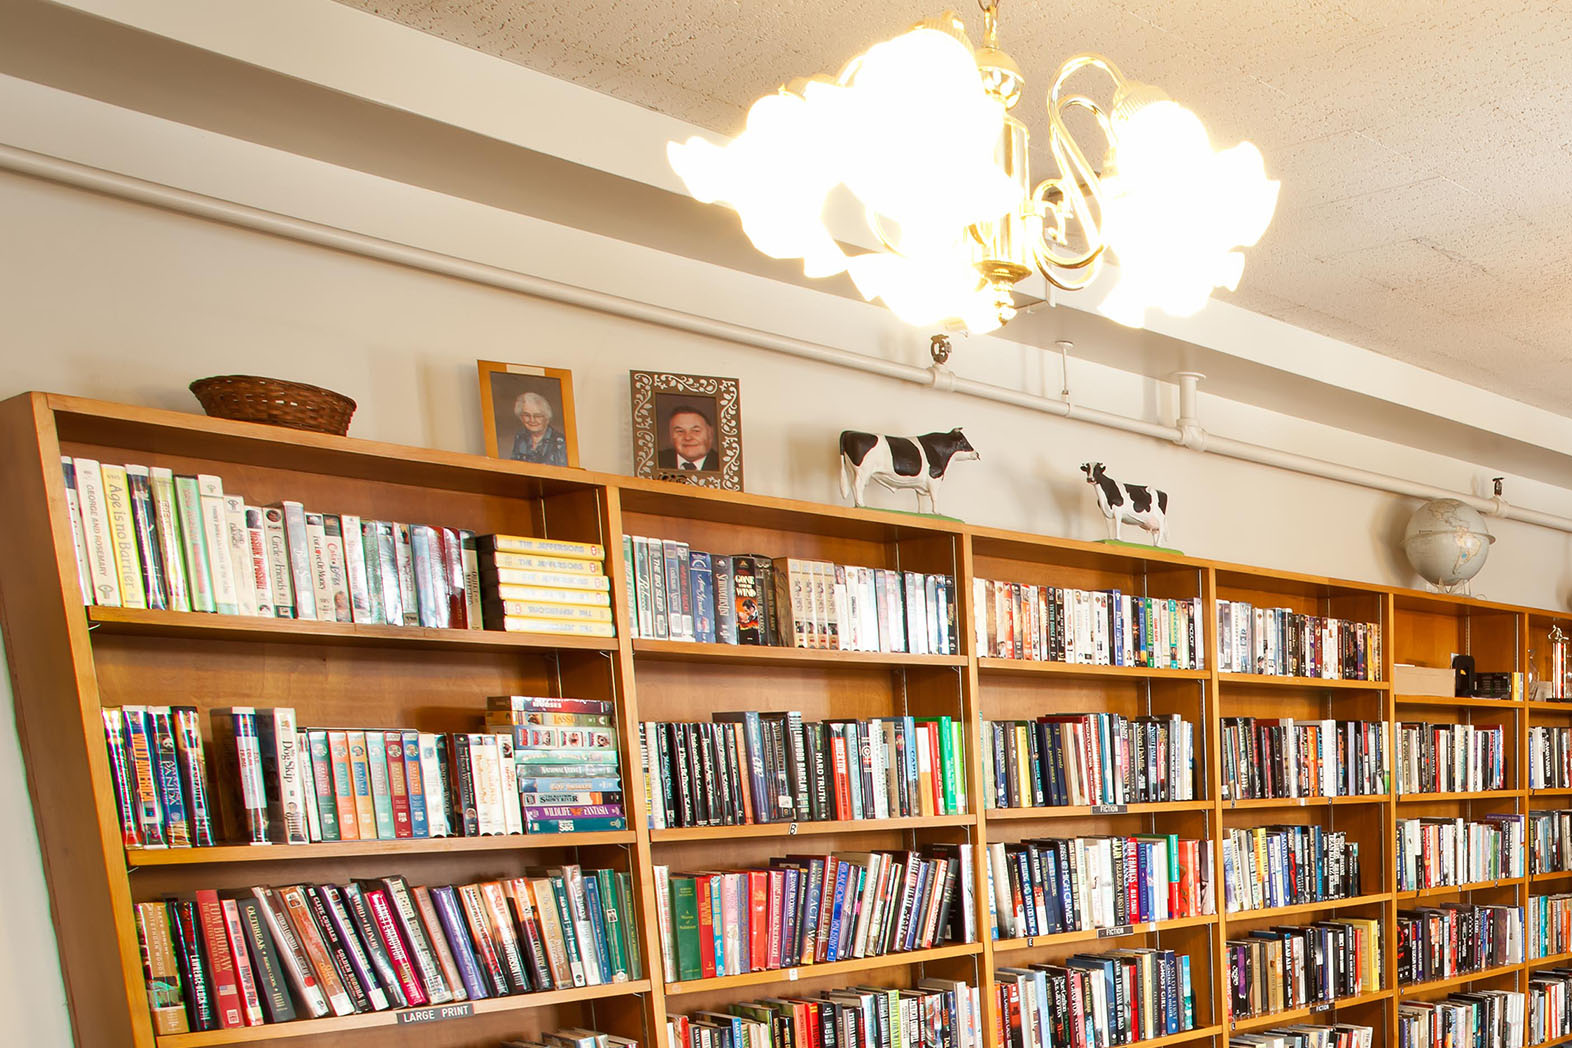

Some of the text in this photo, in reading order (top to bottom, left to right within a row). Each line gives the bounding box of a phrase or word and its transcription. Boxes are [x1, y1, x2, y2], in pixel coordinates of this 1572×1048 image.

[734, 574, 755, 585] GONE
[543, 807, 609, 817] WILDLIFE FANTASIA
[1100, 805, 1118, 813] FICTION
[1106, 927, 1124, 936] FICTION
[403, 1006, 469, 1023] LARGE PRINT
